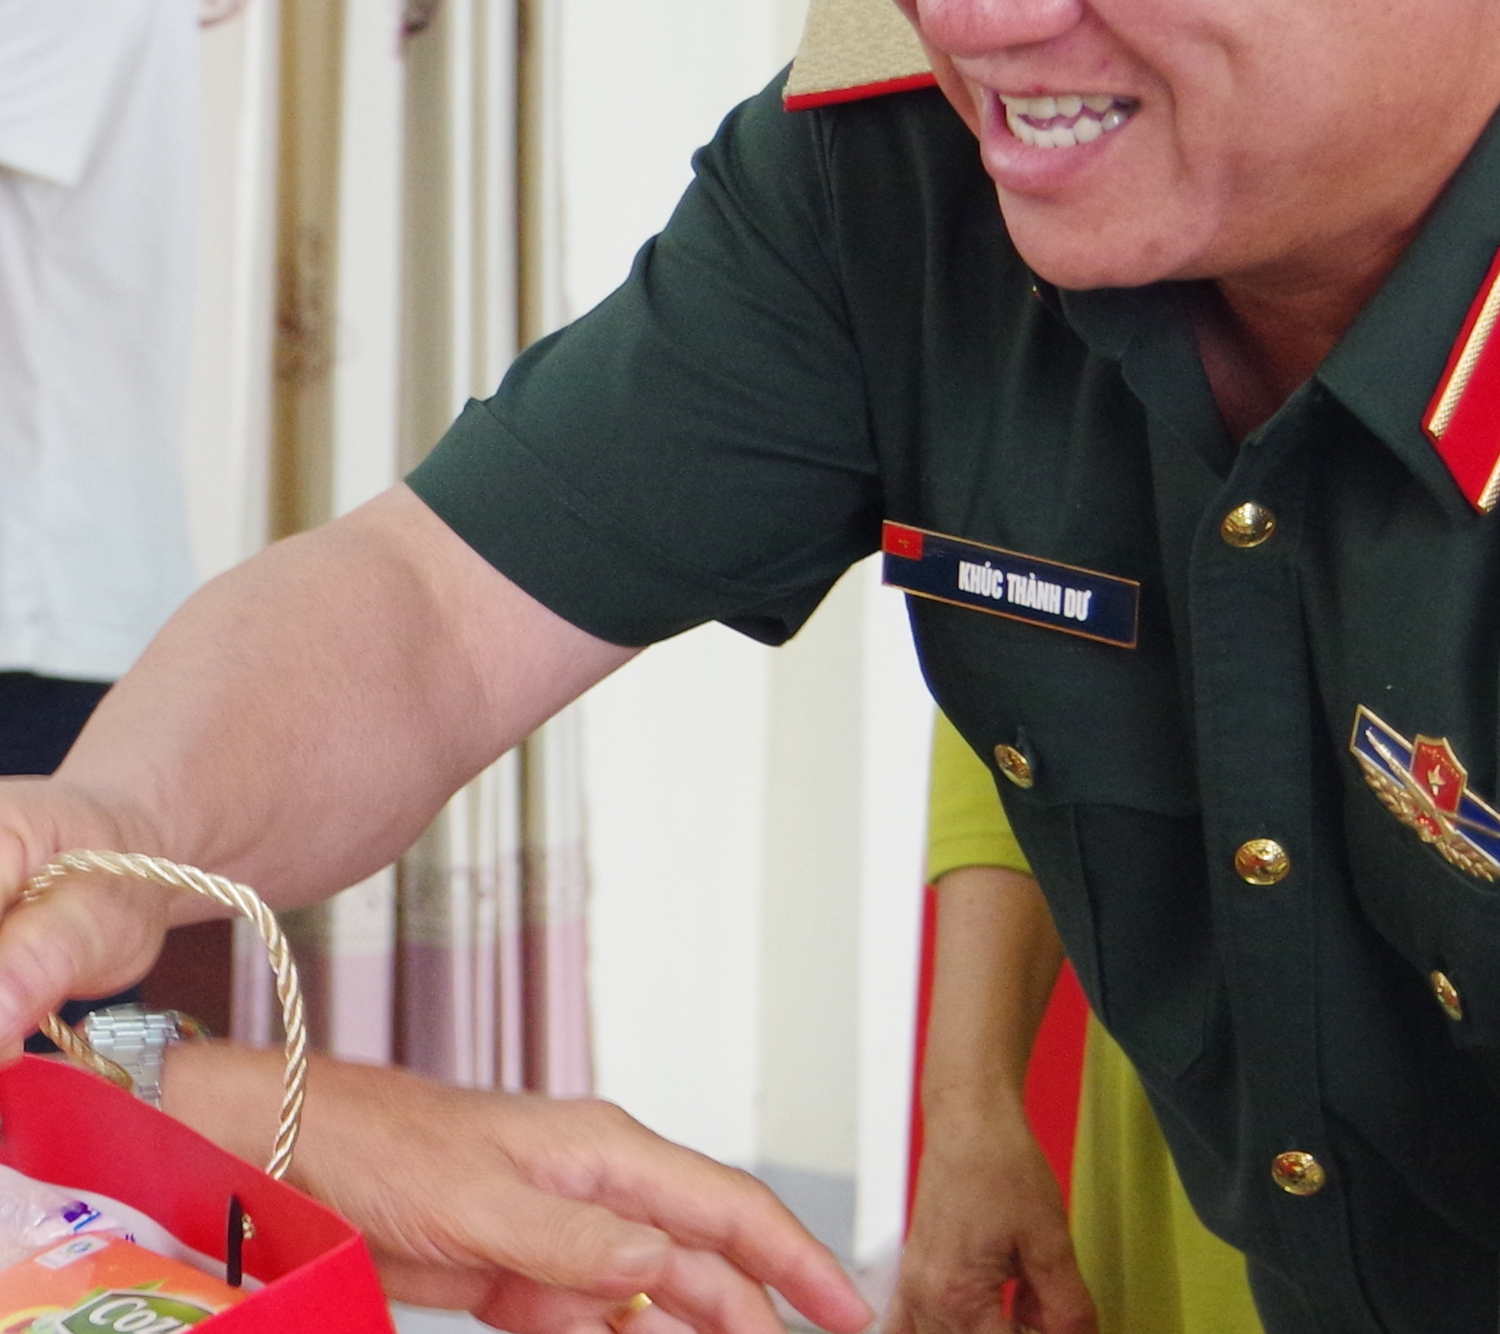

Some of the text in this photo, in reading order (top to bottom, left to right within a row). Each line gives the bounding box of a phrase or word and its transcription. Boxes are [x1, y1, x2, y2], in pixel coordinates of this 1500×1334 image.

[957, 560, 1093, 622] KHÚC THÀNH DƯ
